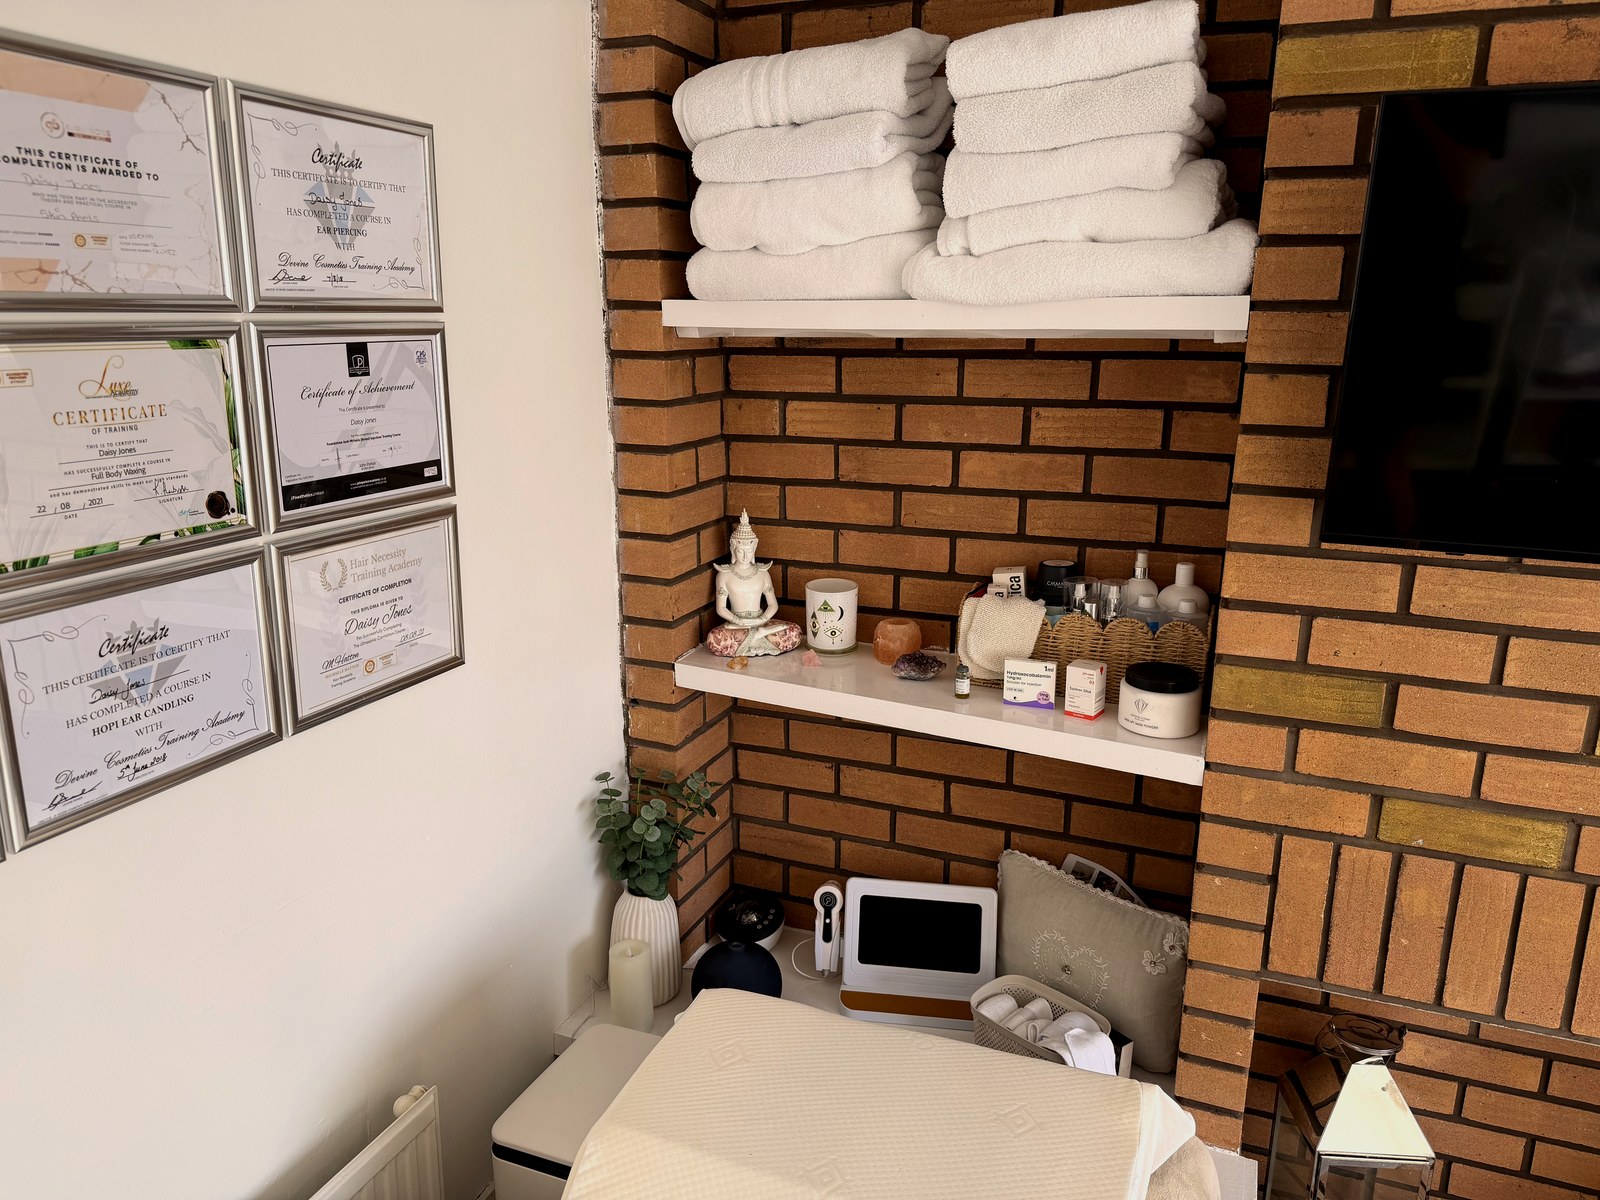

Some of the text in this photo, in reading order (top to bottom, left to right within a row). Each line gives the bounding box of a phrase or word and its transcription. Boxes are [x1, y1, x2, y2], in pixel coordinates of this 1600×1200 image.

[0, 155, 159, 181] OMPLETION IS AWARDED TO
[16, 146, 138, 169] THIS CERTIFICATE OF
[311, 148, 363, 173] Certificate
[271, 168, 291, 178] THIS
[359, 180, 388, 191] CERTIFY
[389, 184, 406, 193] THAT
[286, 208, 303, 217] HAS
[303, 209, 348, 221] COMPLETED
[356, 215, 383, 225] COURSE
[384, 216, 391, 225] IN
[317, 226, 368, 237] EAR PIERCING
[335, 242, 355, 251] WITH
[278, 251, 415, 275] Devine Cosmetics Training Academy
[110, 388, 139, 398] Academy
[300, 377, 416, 408] Certificate of Achievement
[53, 404, 168, 426] CERTIFICATE
[364, 417, 377, 425] Jones
[92, 424, 139, 435] OF TRAINING
[98, 447, 137, 458] Daisy Jones
[76, 464, 114, 474] SUCCESSFULLY
[115, 462, 141, 470] COMPLETE
[91, 466, 147, 480] Full Body Waxing
[72, 485, 109, 495] demonstrated
[158, 496, 184, 504] SIGNATURE
[37, 505, 46, 513] 22
[60, 502, 71, 510] 08
[88, 498, 103, 506] 2021
[350, 548, 407, 570] Hair Necessity
[351, 557, 423, 583] Training Academy
[338, 590, 371, 604] CERTIFICATE
[380, 578, 412, 591] COMPLETION
[361, 603, 379, 612] DIPLOMA
[344, 604, 414, 636] Daisy Jones
[98, 625, 169, 658] Certificate
[42, 629, 231, 695] THIS CERTIFCATE IS TO CERTIFY THAT
[66, 714, 88, 729] HAS
[90, 693, 153, 720] COMPLETED
[164, 677, 200, 694] COURSE
[202, 672, 212, 682] IN
[91, 678, 146, 704] Daisy Jones
[92, 694, 195, 737] HOPI EAR CANDLING
[135, 721, 163, 737] WITH
[54, 710, 245, 790] Devine Cosmetics Training Academy
[128, 762, 149, 782] June
